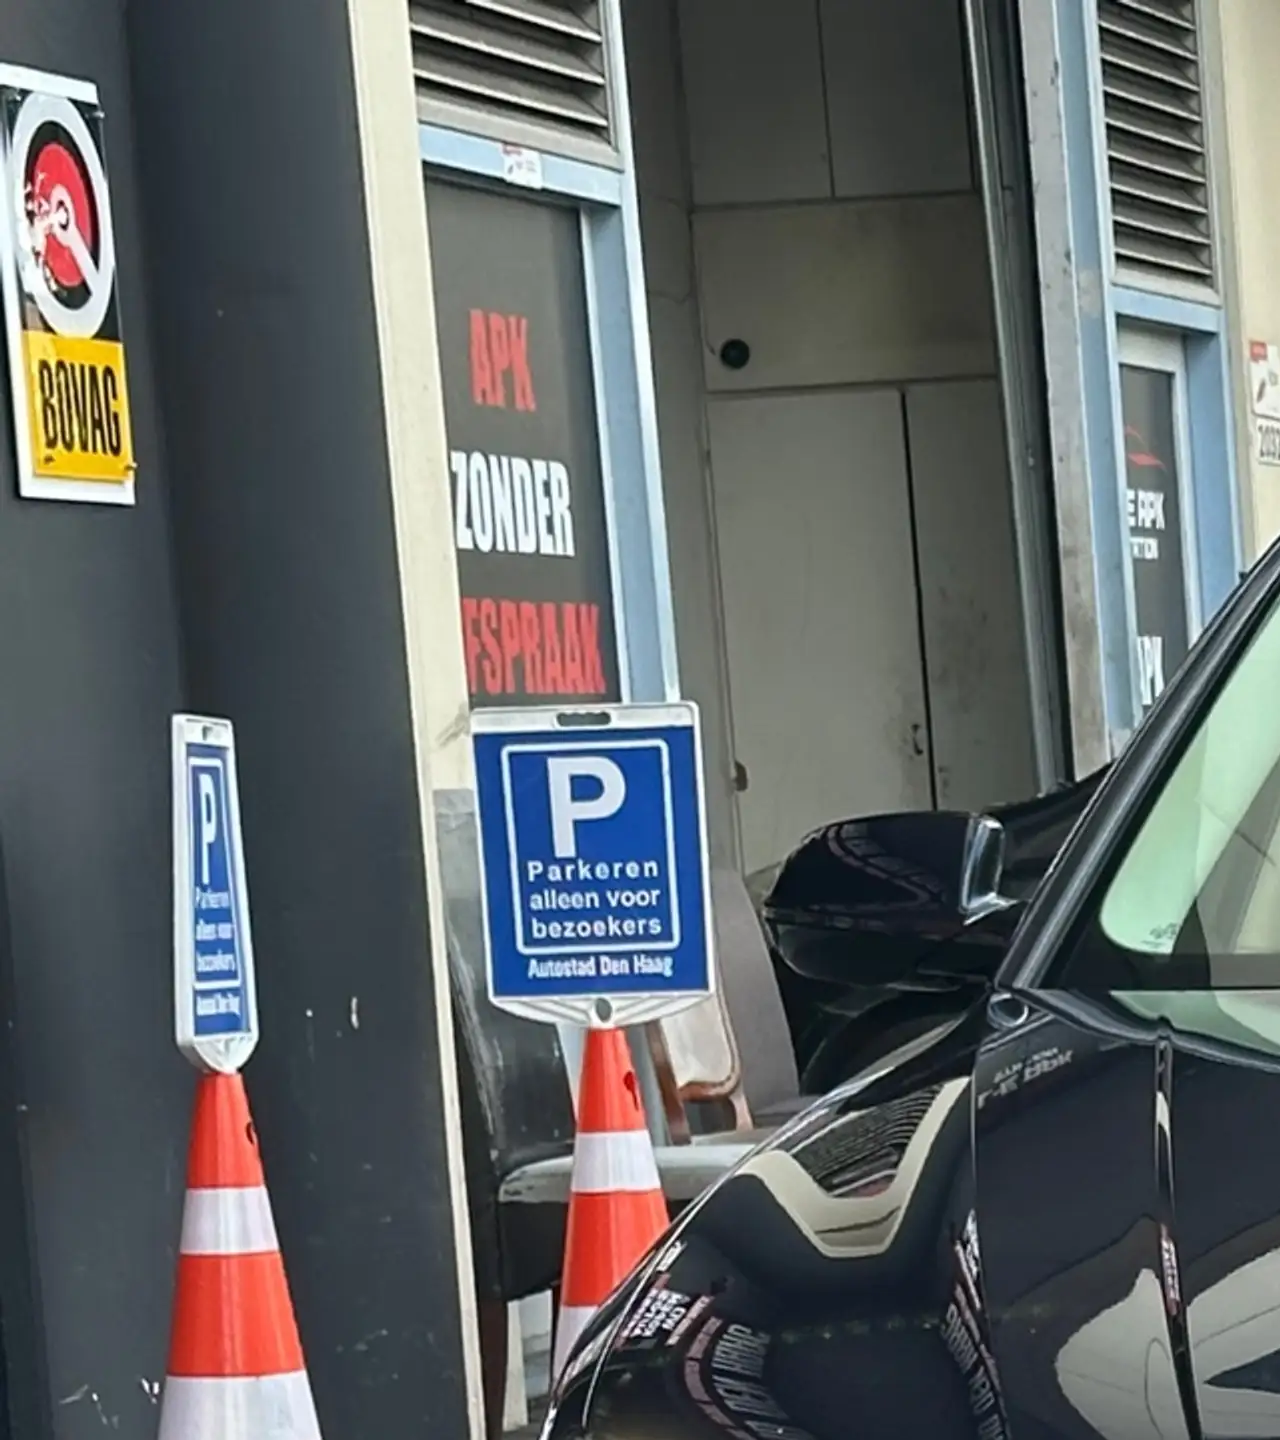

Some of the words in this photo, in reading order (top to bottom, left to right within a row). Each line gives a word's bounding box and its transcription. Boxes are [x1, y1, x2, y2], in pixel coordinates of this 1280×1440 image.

[38, 358, 122, 458] BOVAG
[469, 308, 536, 412] APK
[450, 450, 575, 557] ZONDER
[463, 597, 607, 695] FSPRAAK
[199, 773, 218, 885] P
[546, 756, 627, 858] P
[527, 859, 660, 882] Parkeren
[529, 889, 600, 911] alleen
[606, 889, 661, 908] voor
[527, 955, 597, 979] Autostad
[599, 954, 630, 976] Den
[633, 953, 674, 978] Haag
[531, 915, 662, 939] bezoekers
